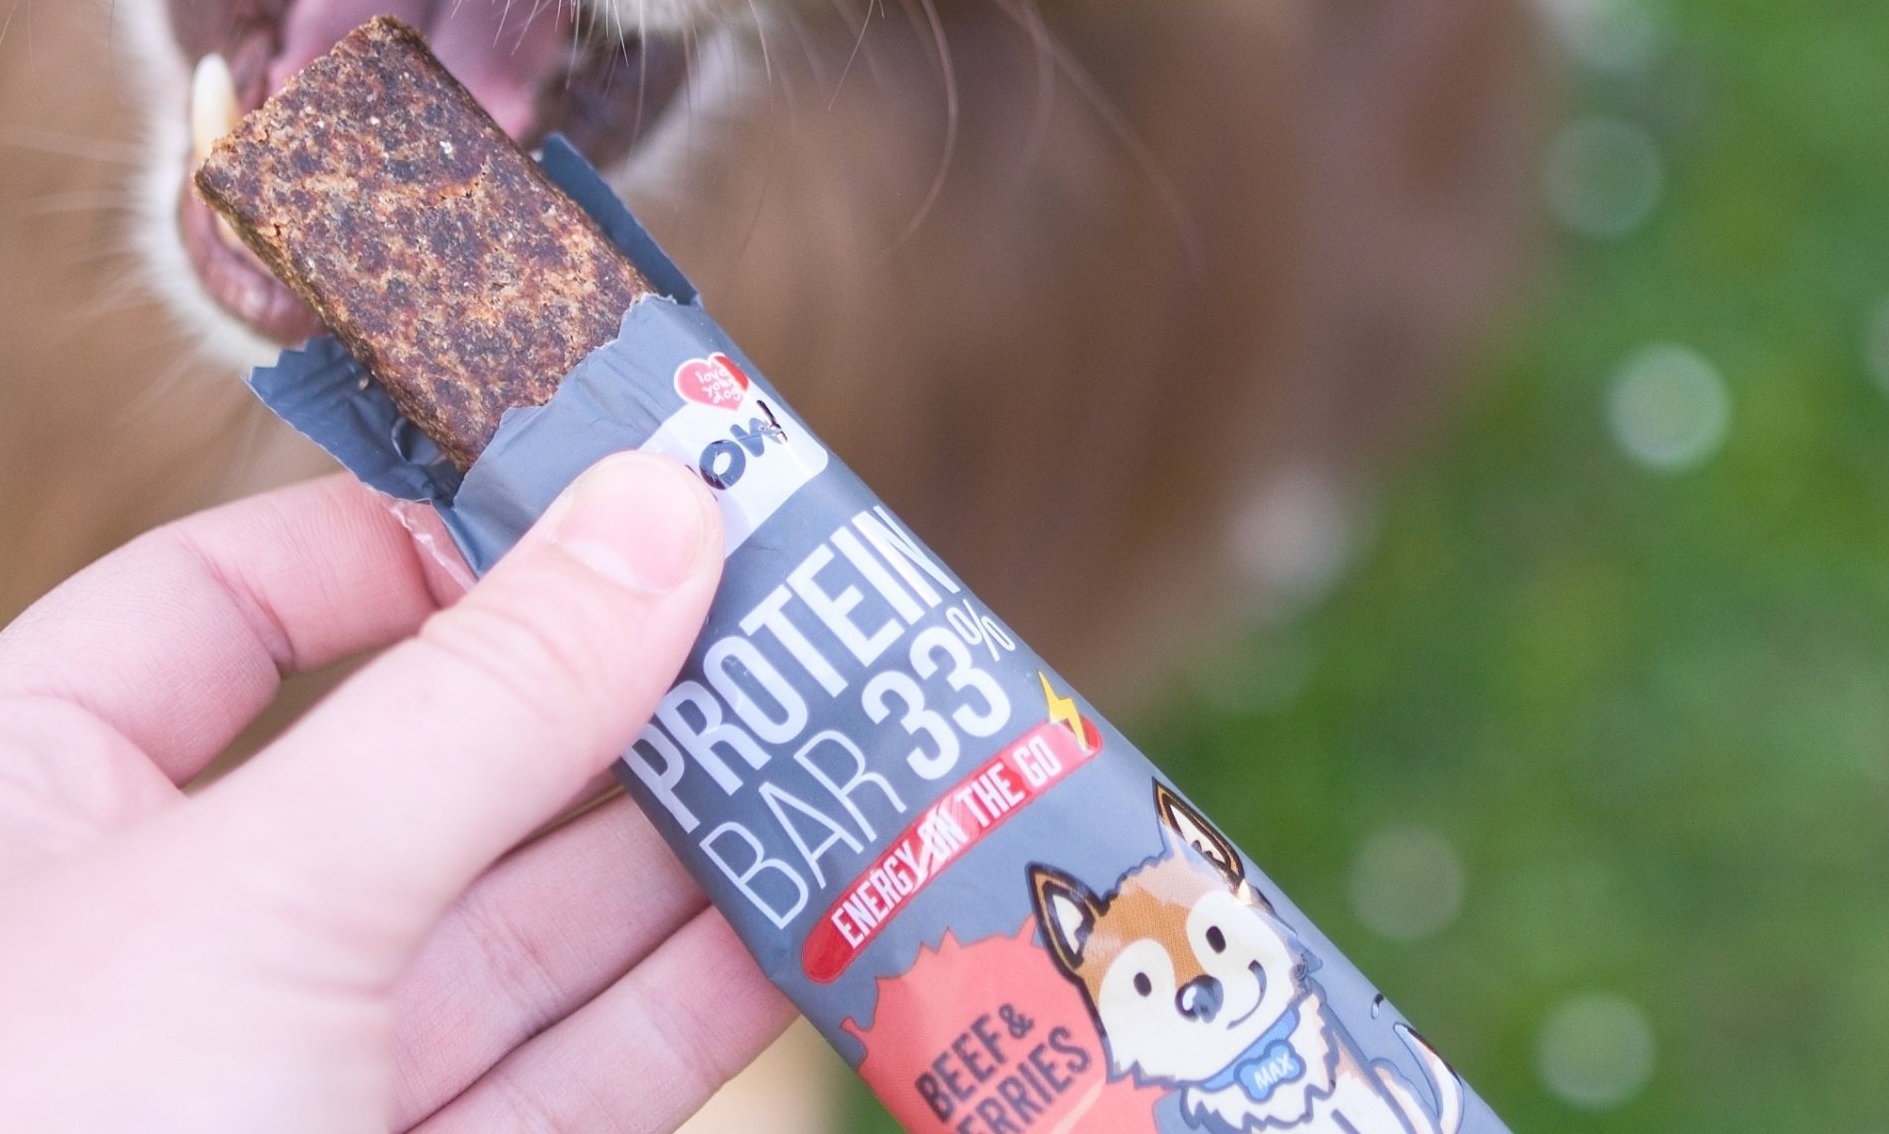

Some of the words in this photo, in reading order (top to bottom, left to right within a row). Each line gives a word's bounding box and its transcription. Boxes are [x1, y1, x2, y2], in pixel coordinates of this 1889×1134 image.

[621, 505, 961, 834] PROTEIN
[699, 729, 907, 930] BAR
[861, 599, 1017, 780] 33%
[831, 839, 928, 949] ENERGY
[917, 806, 969, 862] ON
[956, 763, 1025, 828] THE
[1012, 735, 1062, 788] GO
[1254, 1051, 1294, 1091] MAX
